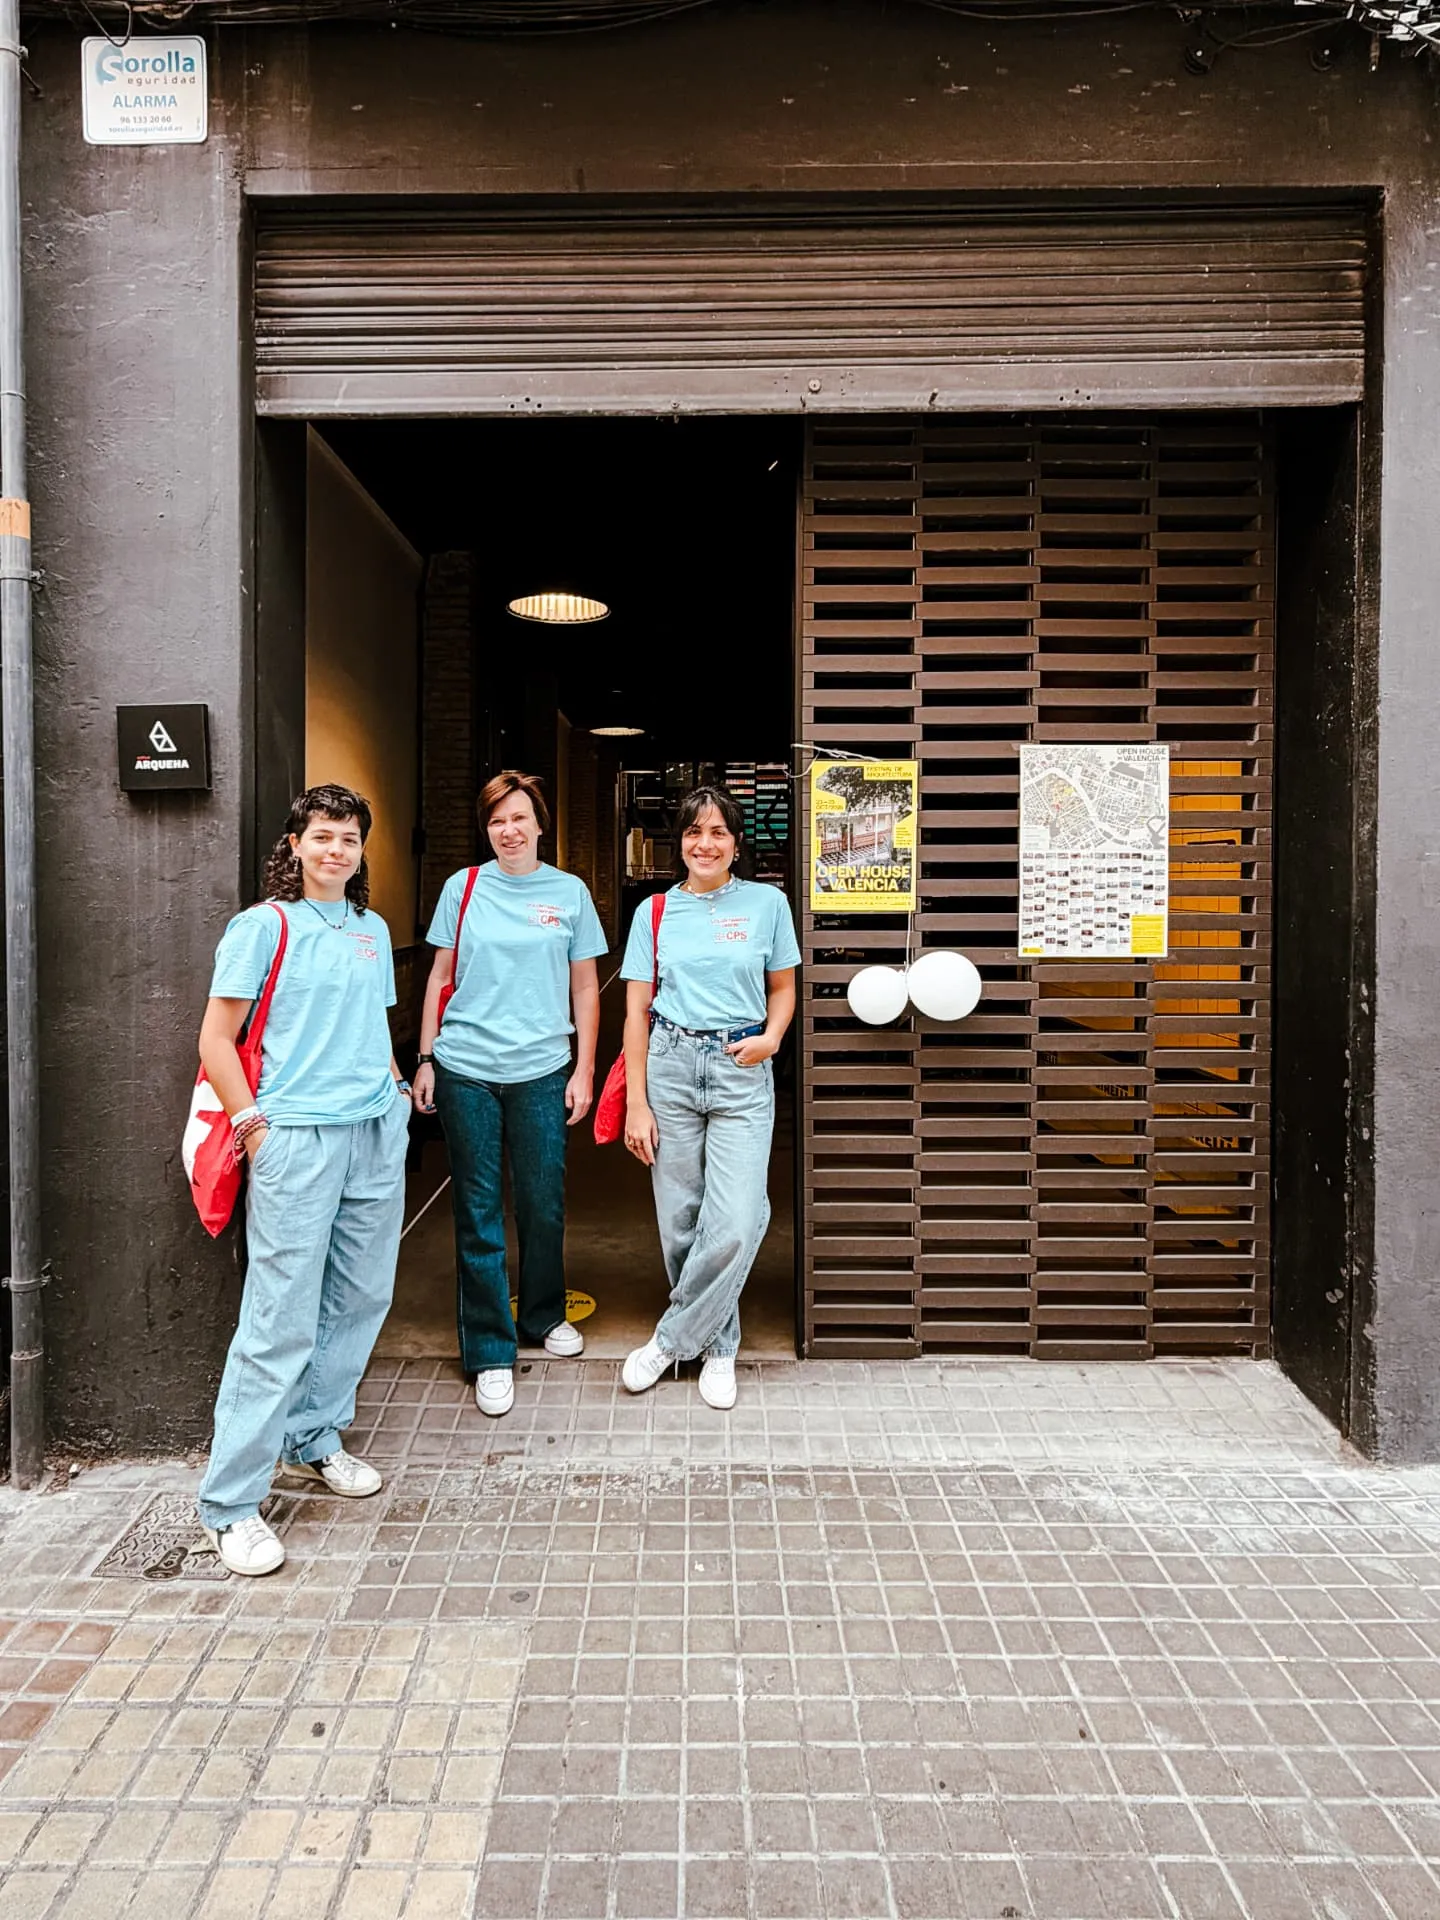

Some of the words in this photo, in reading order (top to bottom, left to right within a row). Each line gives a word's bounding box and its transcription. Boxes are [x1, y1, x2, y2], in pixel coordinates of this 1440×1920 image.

[96, 45, 195, 86] Sorolla
[113, 95, 178, 108] ALARMA
[120, 116, 130, 124] 96
[150, 115, 160, 123] 20
[134, 759, 190, 771] ARQUEHA
[817, 865, 857, 878] OPEN
[860, 865, 911, 878] HOUSE
[828, 878, 899, 891] VALENCIA
[726, 931, 748, 940] CPS
